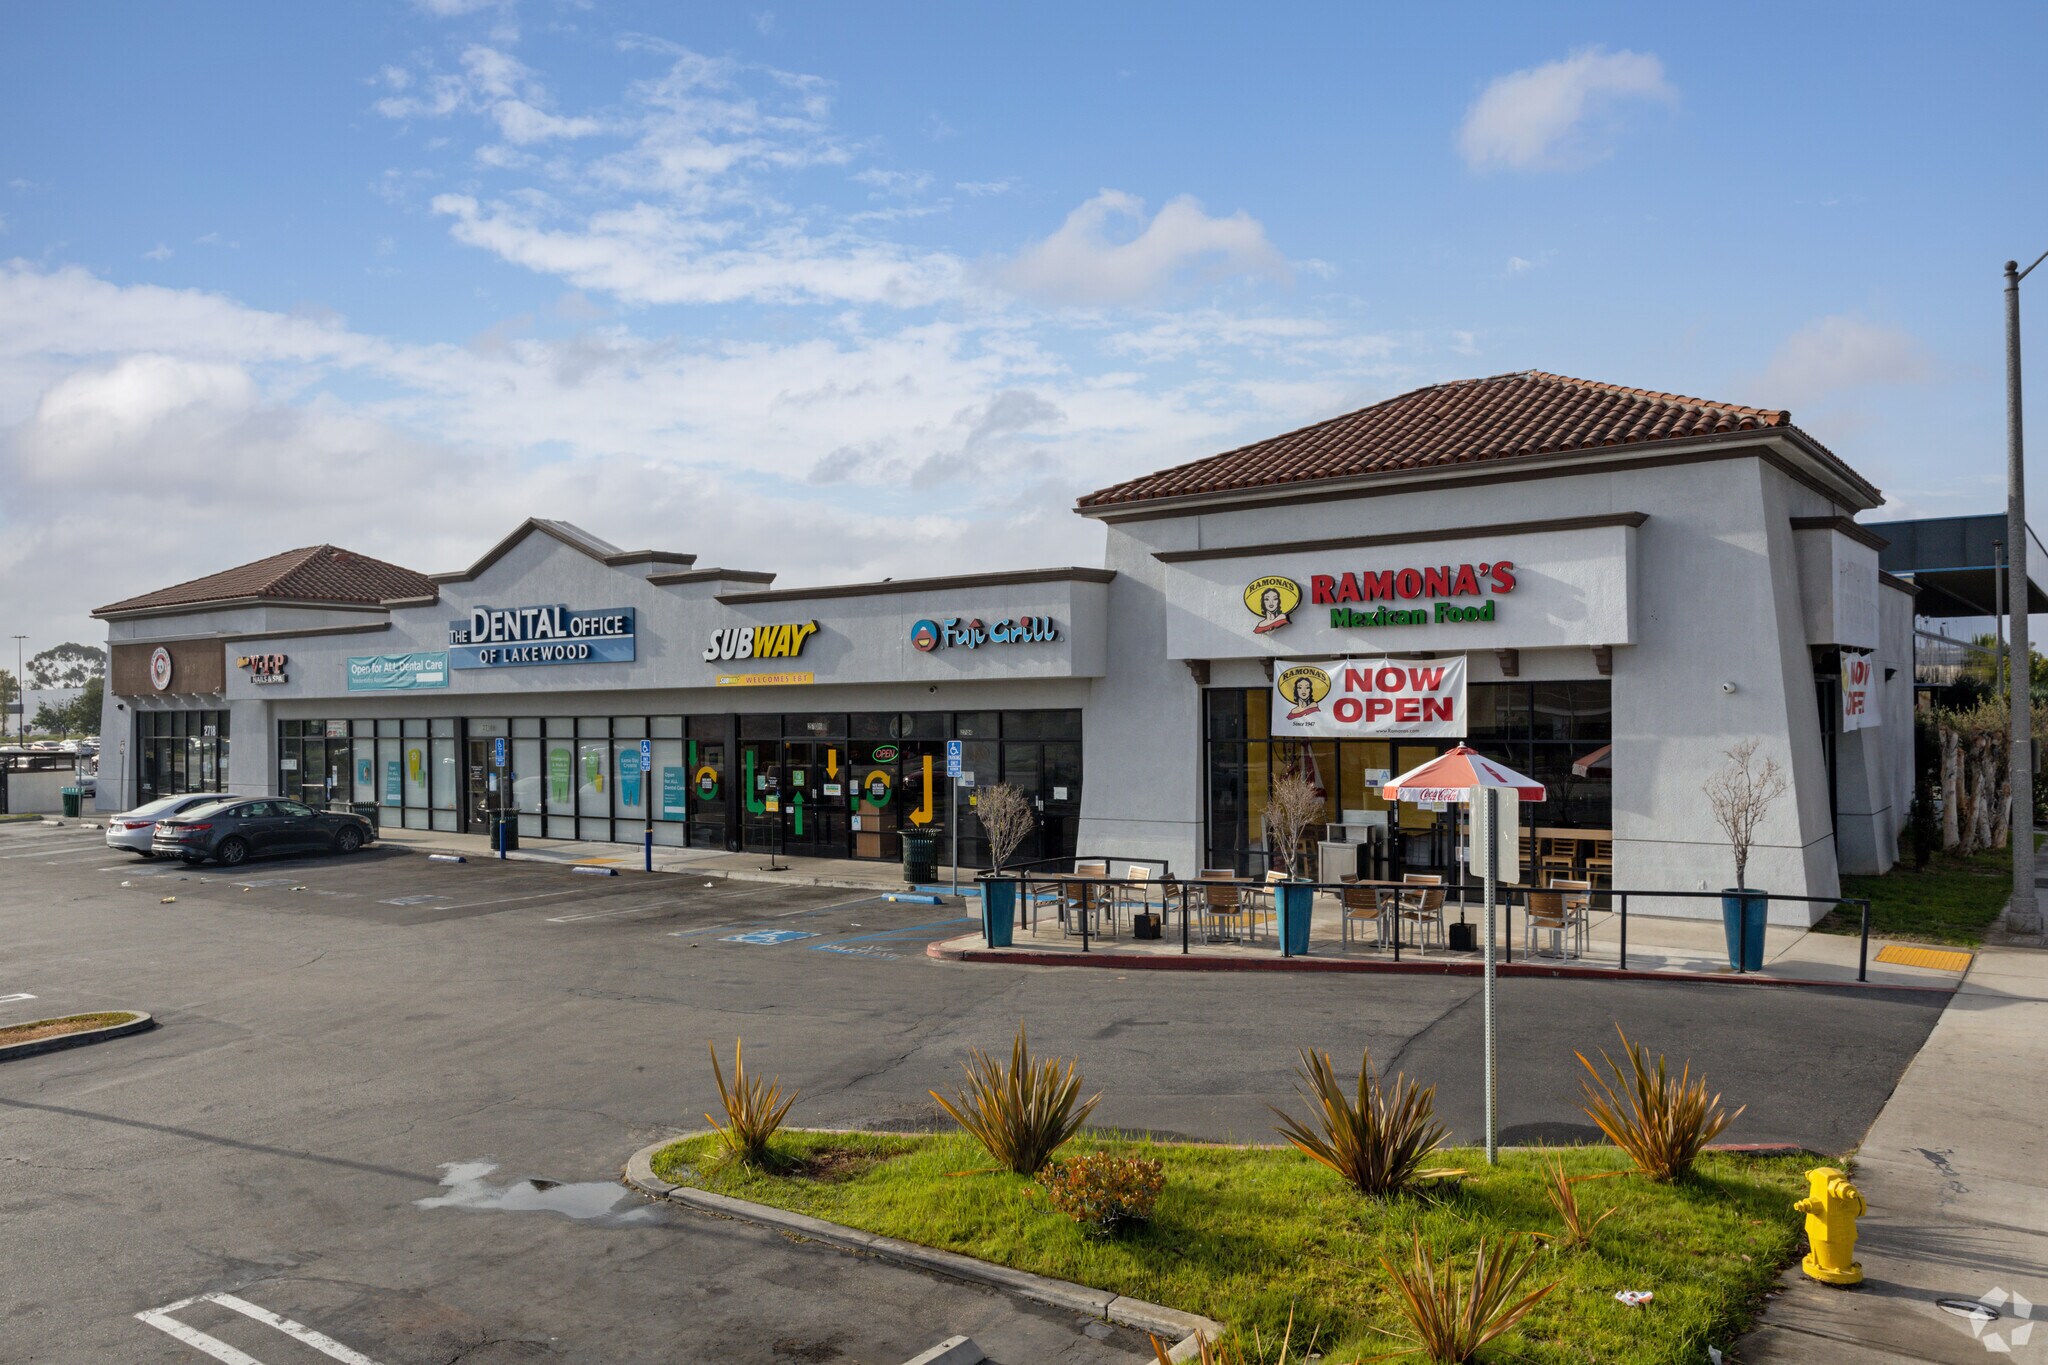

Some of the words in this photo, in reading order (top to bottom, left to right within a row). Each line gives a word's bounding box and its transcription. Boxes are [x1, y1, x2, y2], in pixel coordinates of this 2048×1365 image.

[1249, 578, 1295, 594] RAMONA'S
[1310, 561, 1517, 605] RAMONA'S
[450, 630, 468, 643] THE
[471, 607, 567, 643] DENTAL
[570, 615, 623, 636] OFFICE
[1330, 605, 1427, 629] Mexican
[1434, 600, 1495, 624] Food
[702, 620, 818, 661] SUBWAY
[941, 617, 985, 649] Fuji
[989, 616, 1055, 643] Grill
[479, 649, 496, 664] OF
[503, 644, 588, 663] LAKEWOOD
[351, 664, 371, 675] Open
[372, 663, 381, 673] for
[400, 660, 423, 671] Dental
[425, 660, 443, 670] Care
[745, 675, 789, 684] WELCOMES
[1345, 667, 1446, 693] NOW
[1333, 696, 1454, 723] OPEN
[203, 725, 217, 737] 2718
[875, 749, 896, 759] OPEN
[1381, 770, 1389, 780] A
